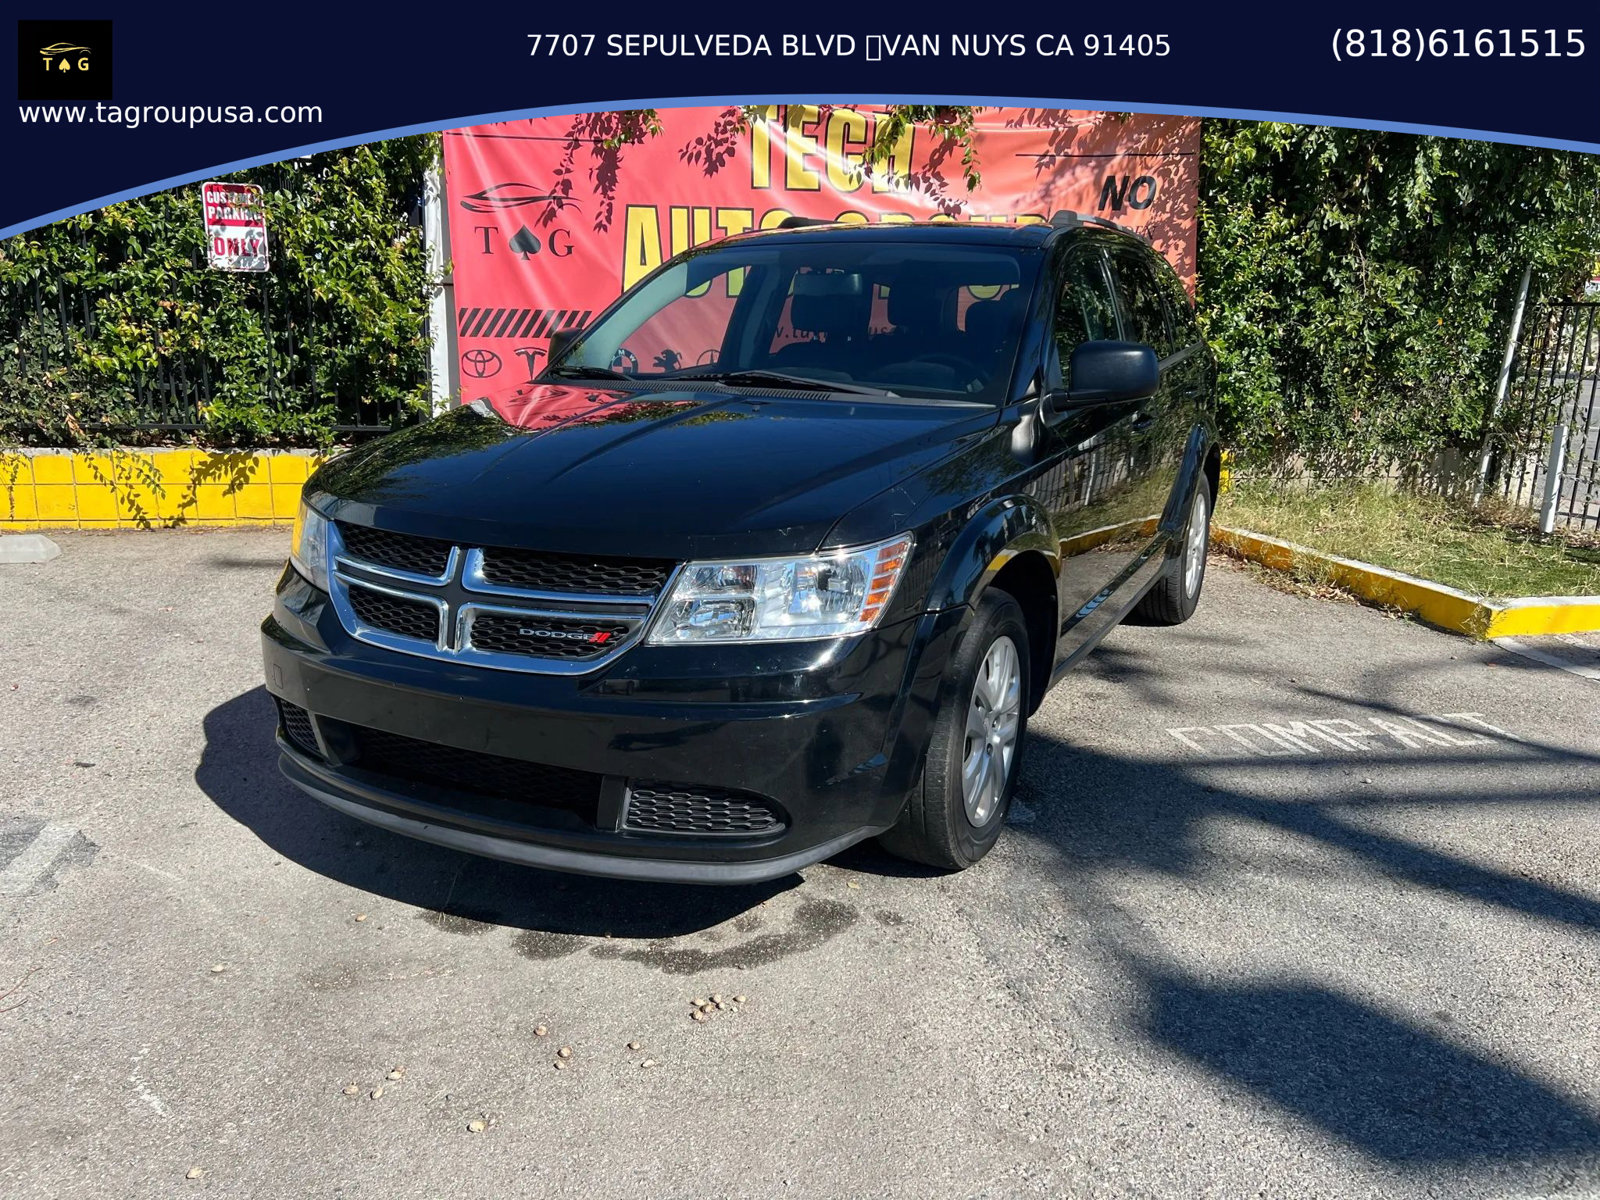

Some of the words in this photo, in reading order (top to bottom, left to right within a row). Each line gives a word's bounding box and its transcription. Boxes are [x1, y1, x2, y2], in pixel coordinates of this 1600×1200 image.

[750, 105, 915, 192] TECH
[1098, 175, 1156, 211] NO
[213, 237, 260, 257] ONLY
[474, 226, 498, 254] T
[549, 229, 574, 257] G
[519, 628, 598, 641] DODGE
[1165, 712, 1520, 756] COMPACT
